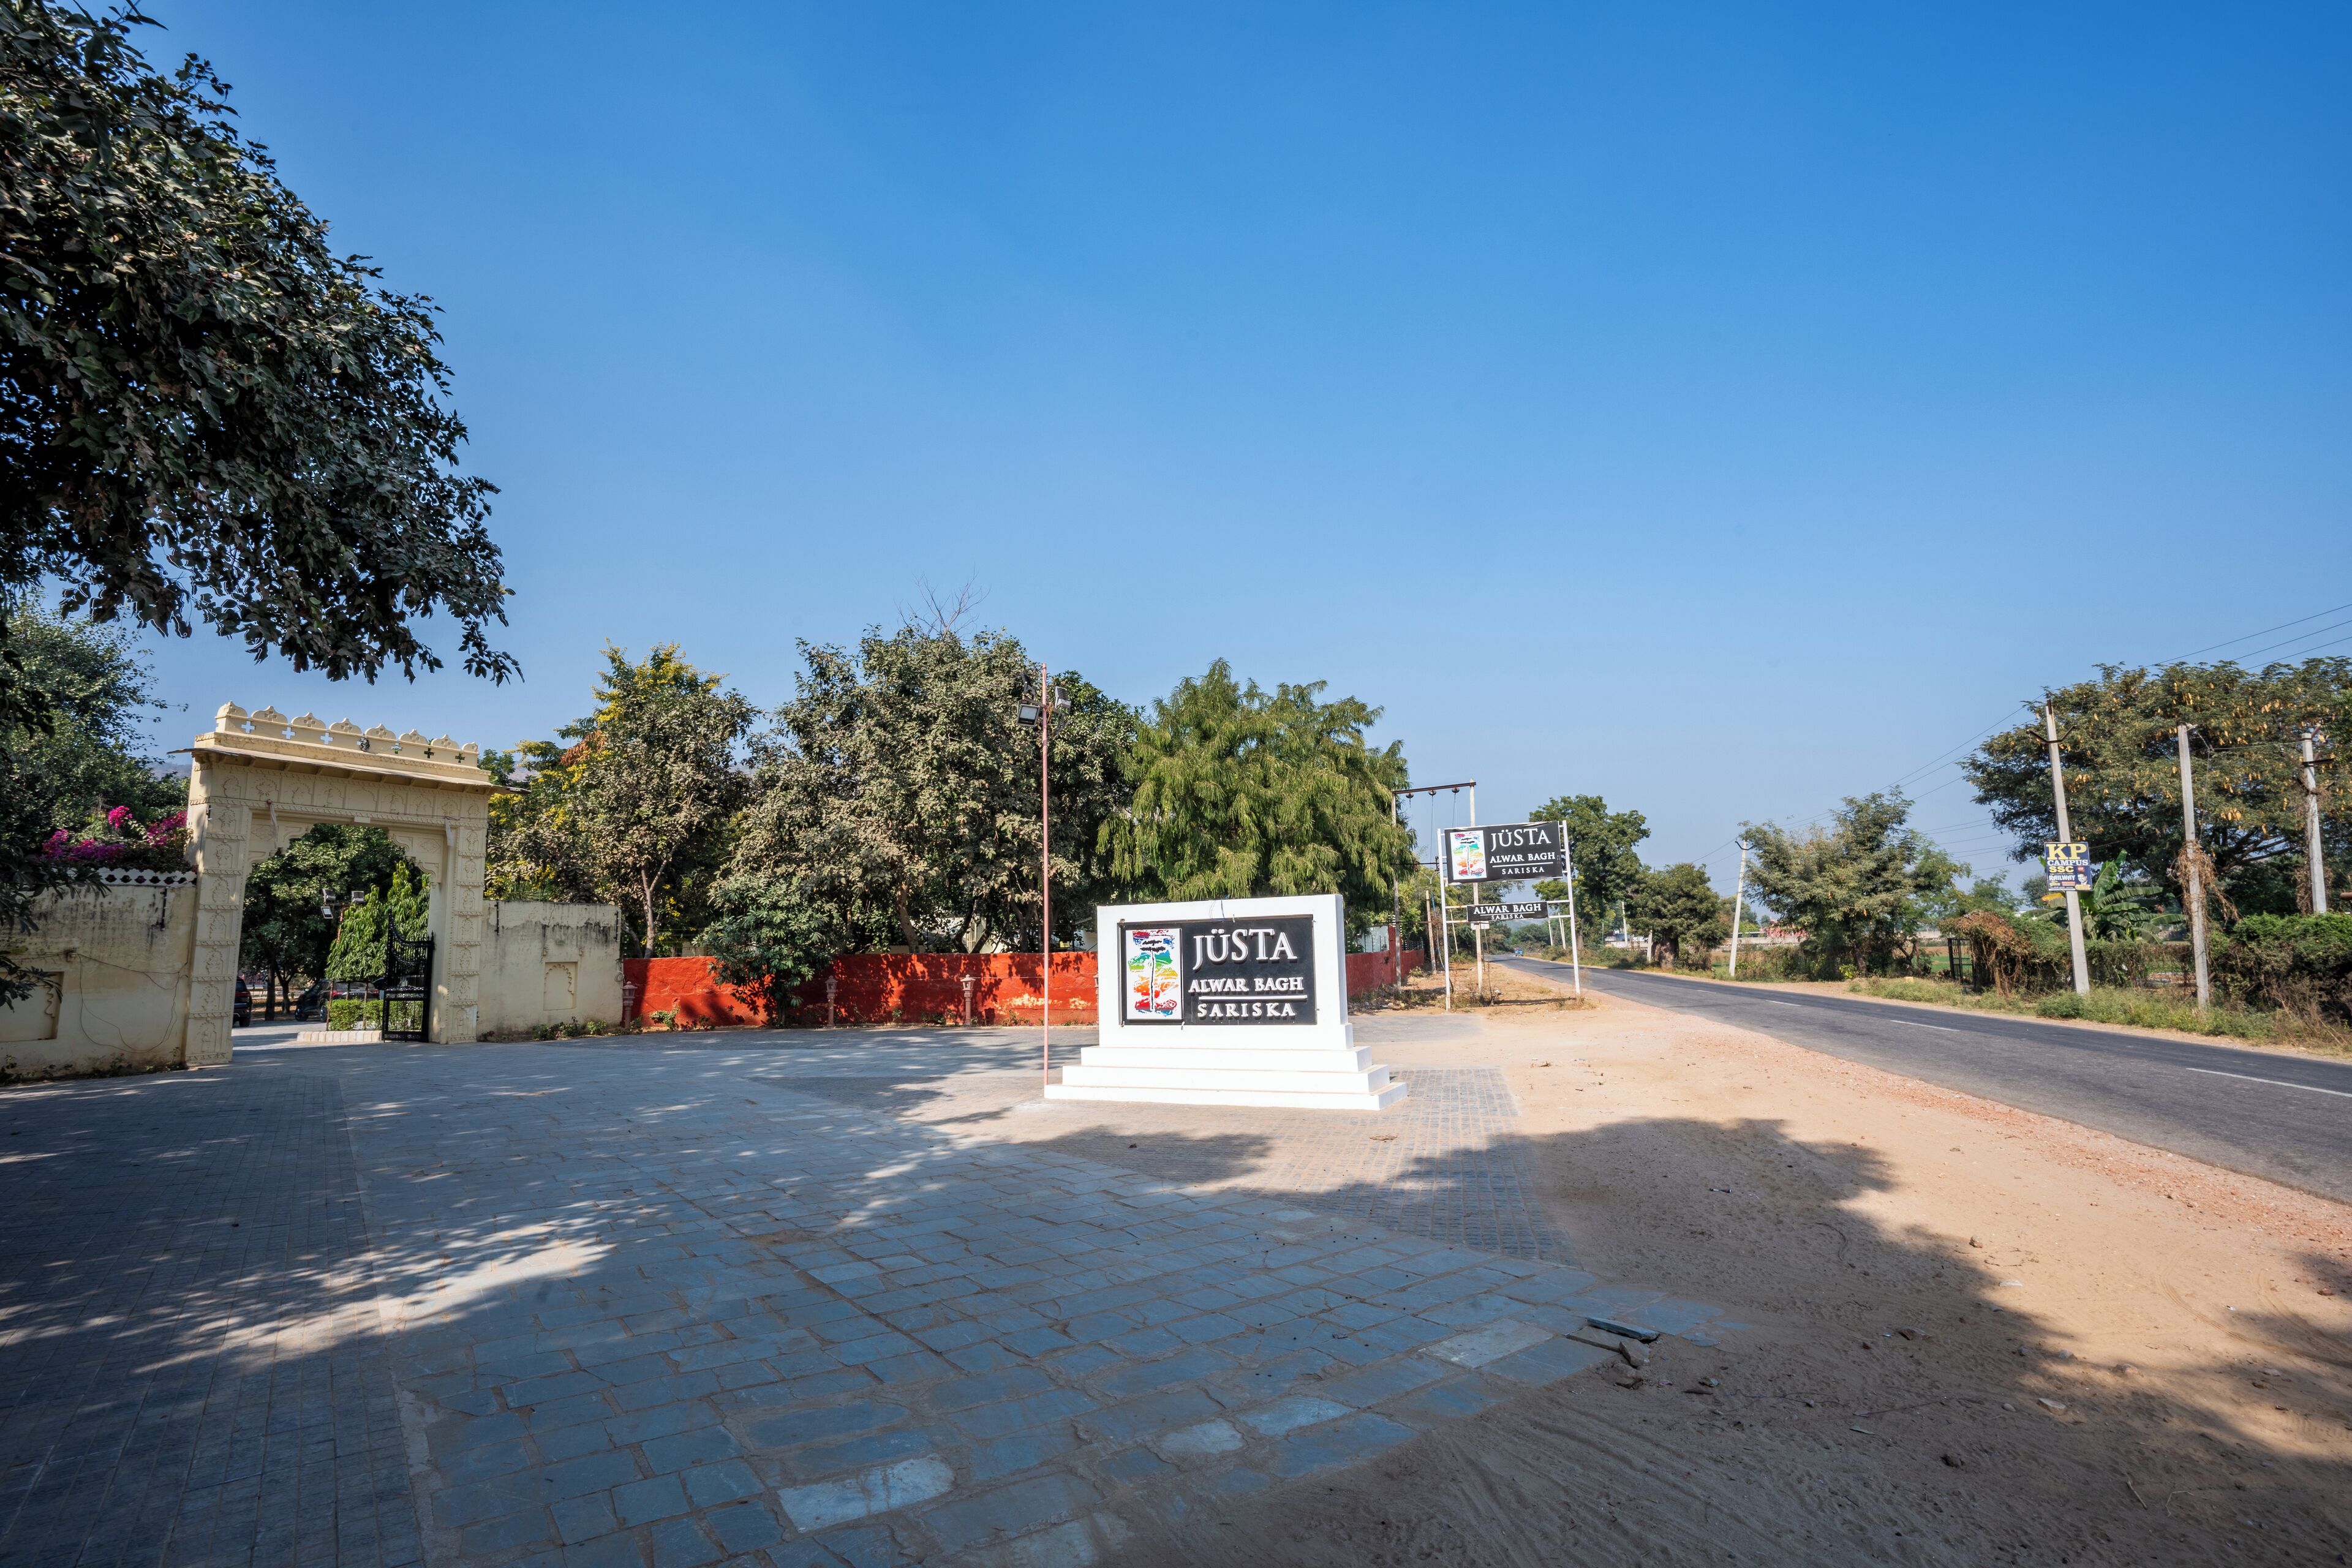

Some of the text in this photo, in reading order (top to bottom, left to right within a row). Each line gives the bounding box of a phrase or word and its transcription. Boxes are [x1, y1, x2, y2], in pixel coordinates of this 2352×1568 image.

[1491, 828, 1551, 851] JÜSTA
[1490, 852, 1555, 864] ALWAR BAGH
[2046, 843, 2087, 860] KP
[1474, 903, 1542, 914] ALWAR BAGH
[1193, 929, 1298, 970] JÜSTA
[1188, 977, 1304, 993] ALWAR BAGH
[1197, 1003, 1296, 1018] SARISKA
